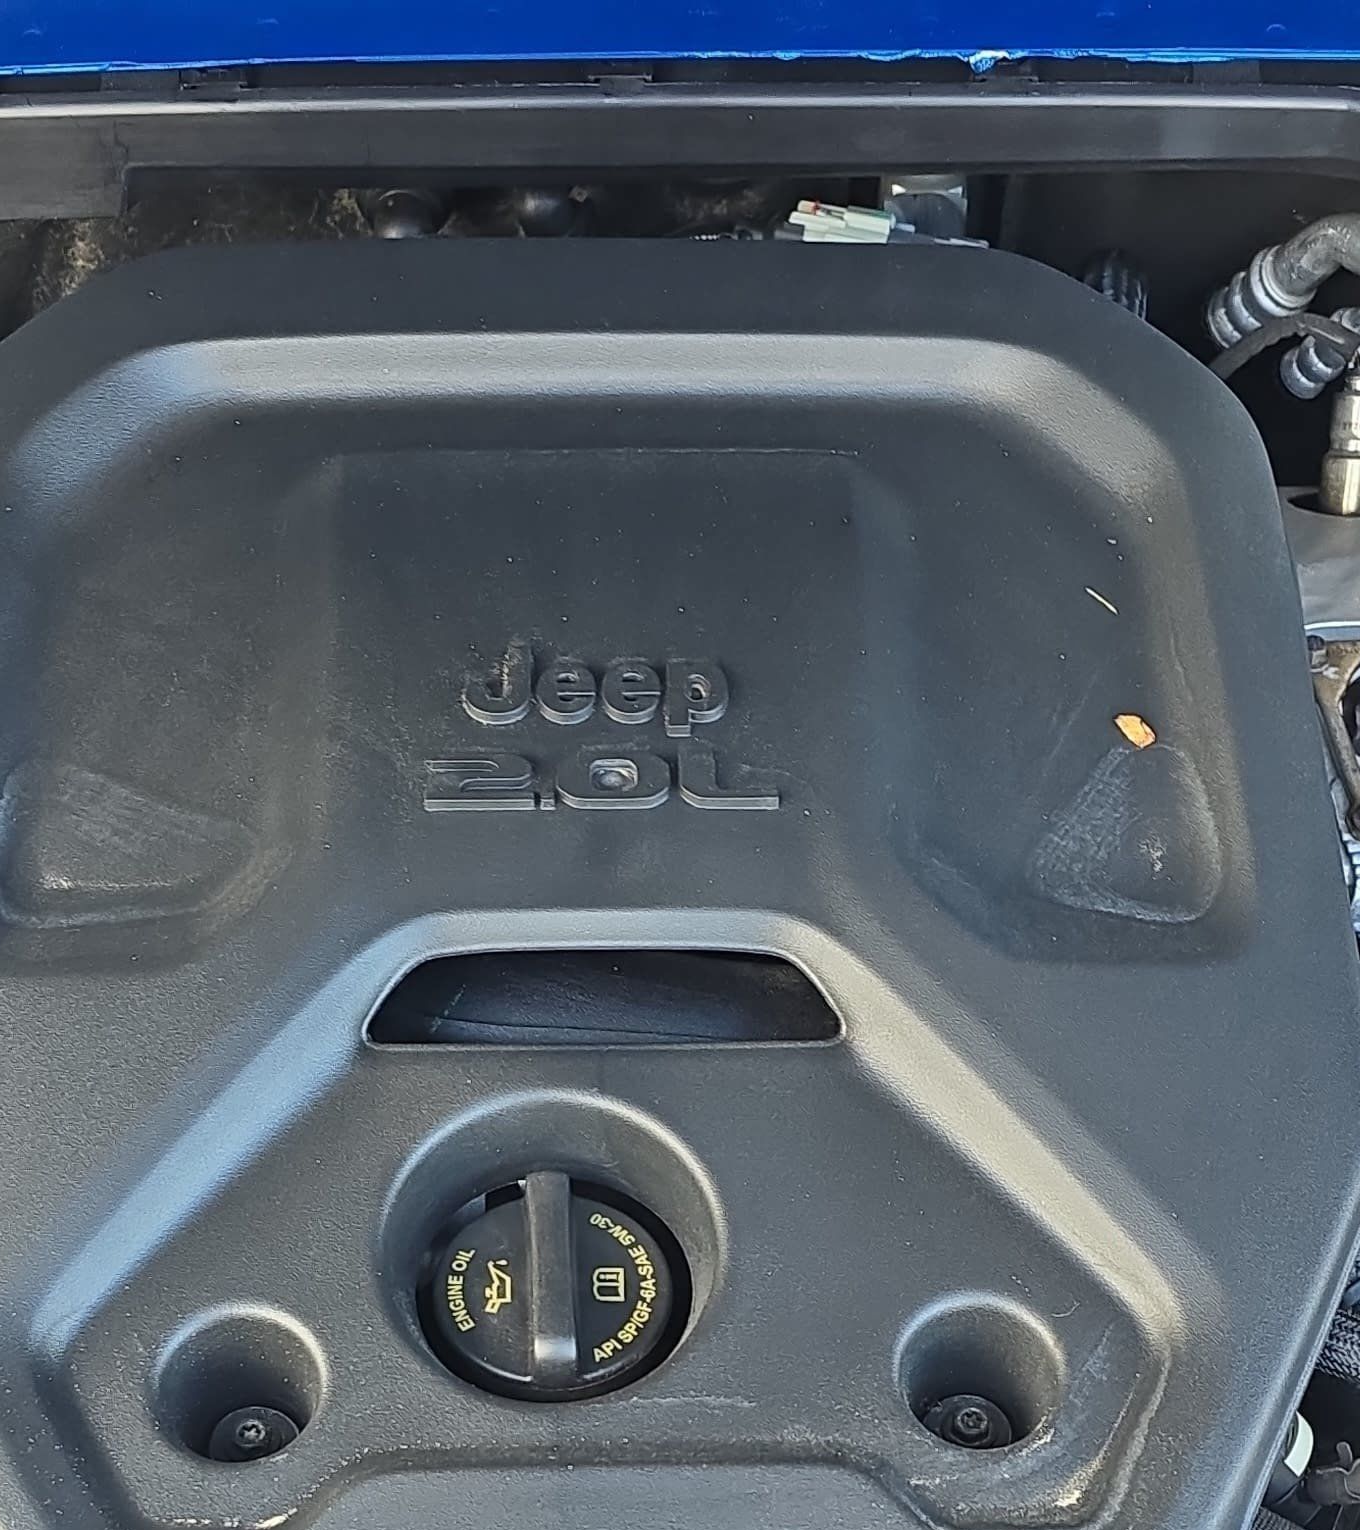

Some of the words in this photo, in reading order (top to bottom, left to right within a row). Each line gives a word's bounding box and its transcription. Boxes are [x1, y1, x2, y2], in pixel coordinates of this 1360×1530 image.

[462, 641, 729, 737] Jeep
[424, 747, 780, 810] 2.0L
[590, 1213, 636, 1247] 5W-30
[451, 1248, 476, 1272] OIL
[447, 1275, 476, 1332] ENGINE
[593, 1338, 624, 1363] API
